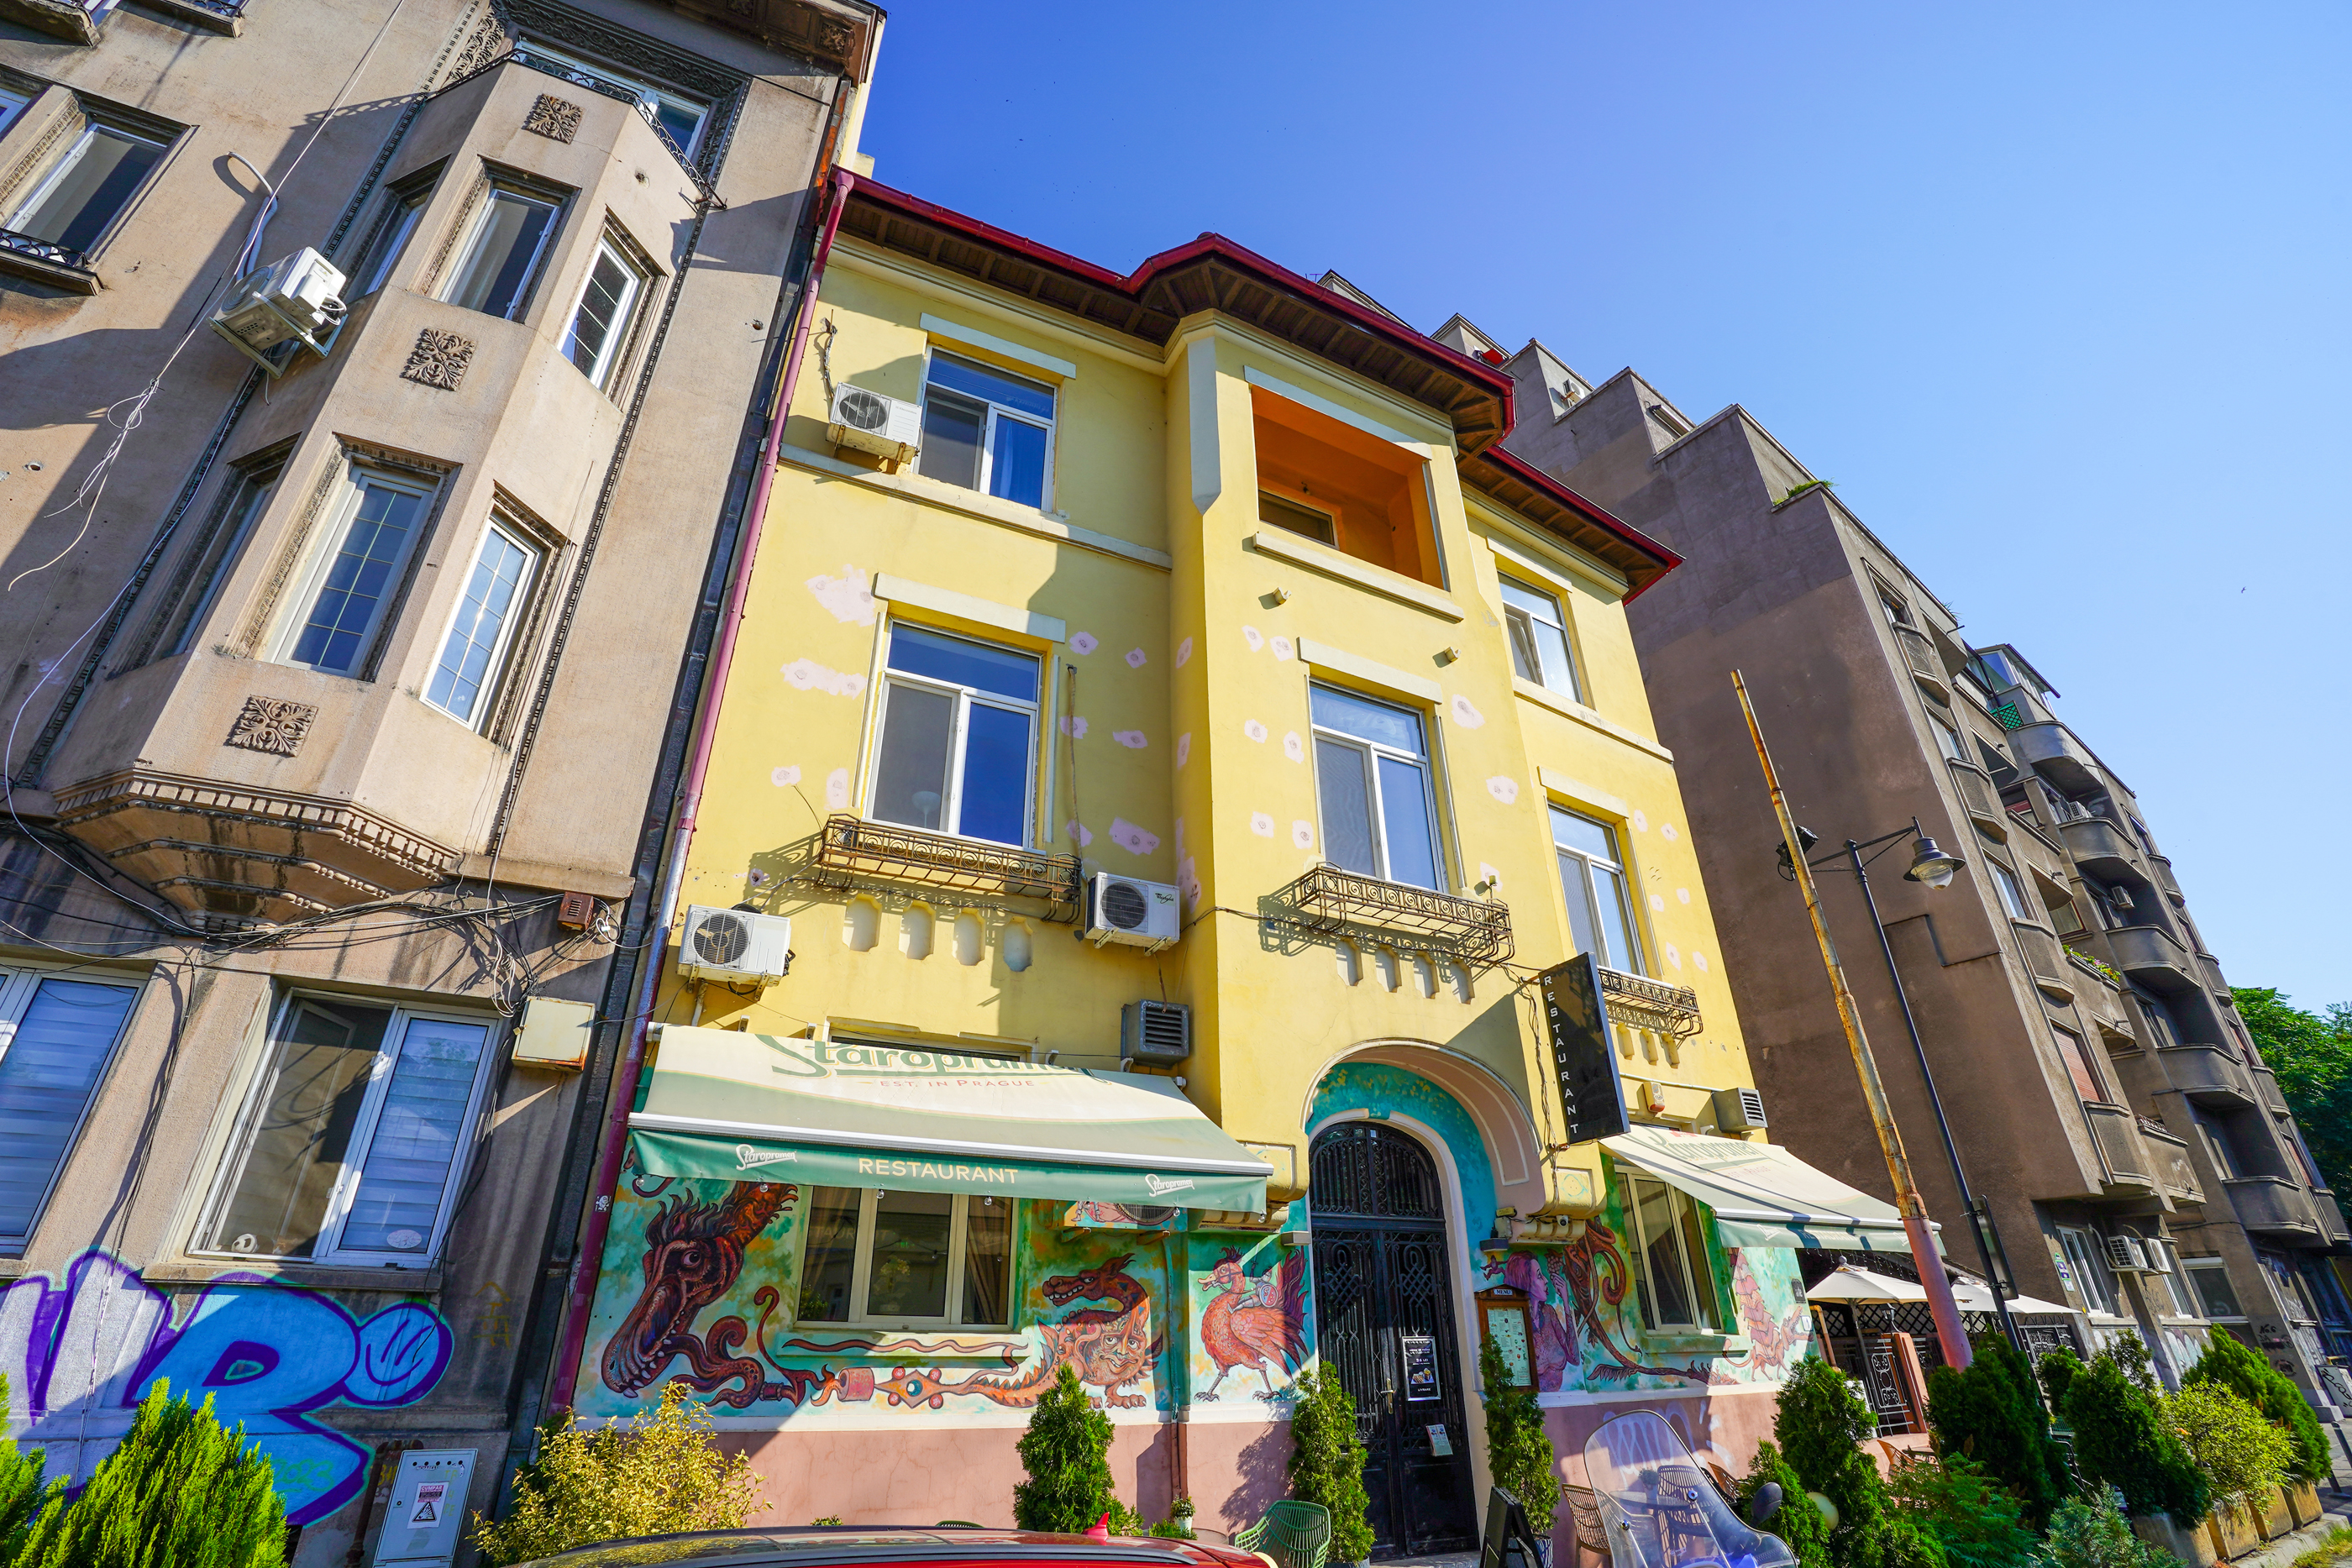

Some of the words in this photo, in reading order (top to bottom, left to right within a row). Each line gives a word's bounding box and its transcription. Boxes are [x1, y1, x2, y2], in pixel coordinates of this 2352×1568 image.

[1543, 975, 1579, 1134] RESTAURANT
[735, 1143, 797, 1172] Staropramen
[858, 1157, 1018, 1184] RESTAURANT
[1144, 1173, 1195, 1198] Staropramen
